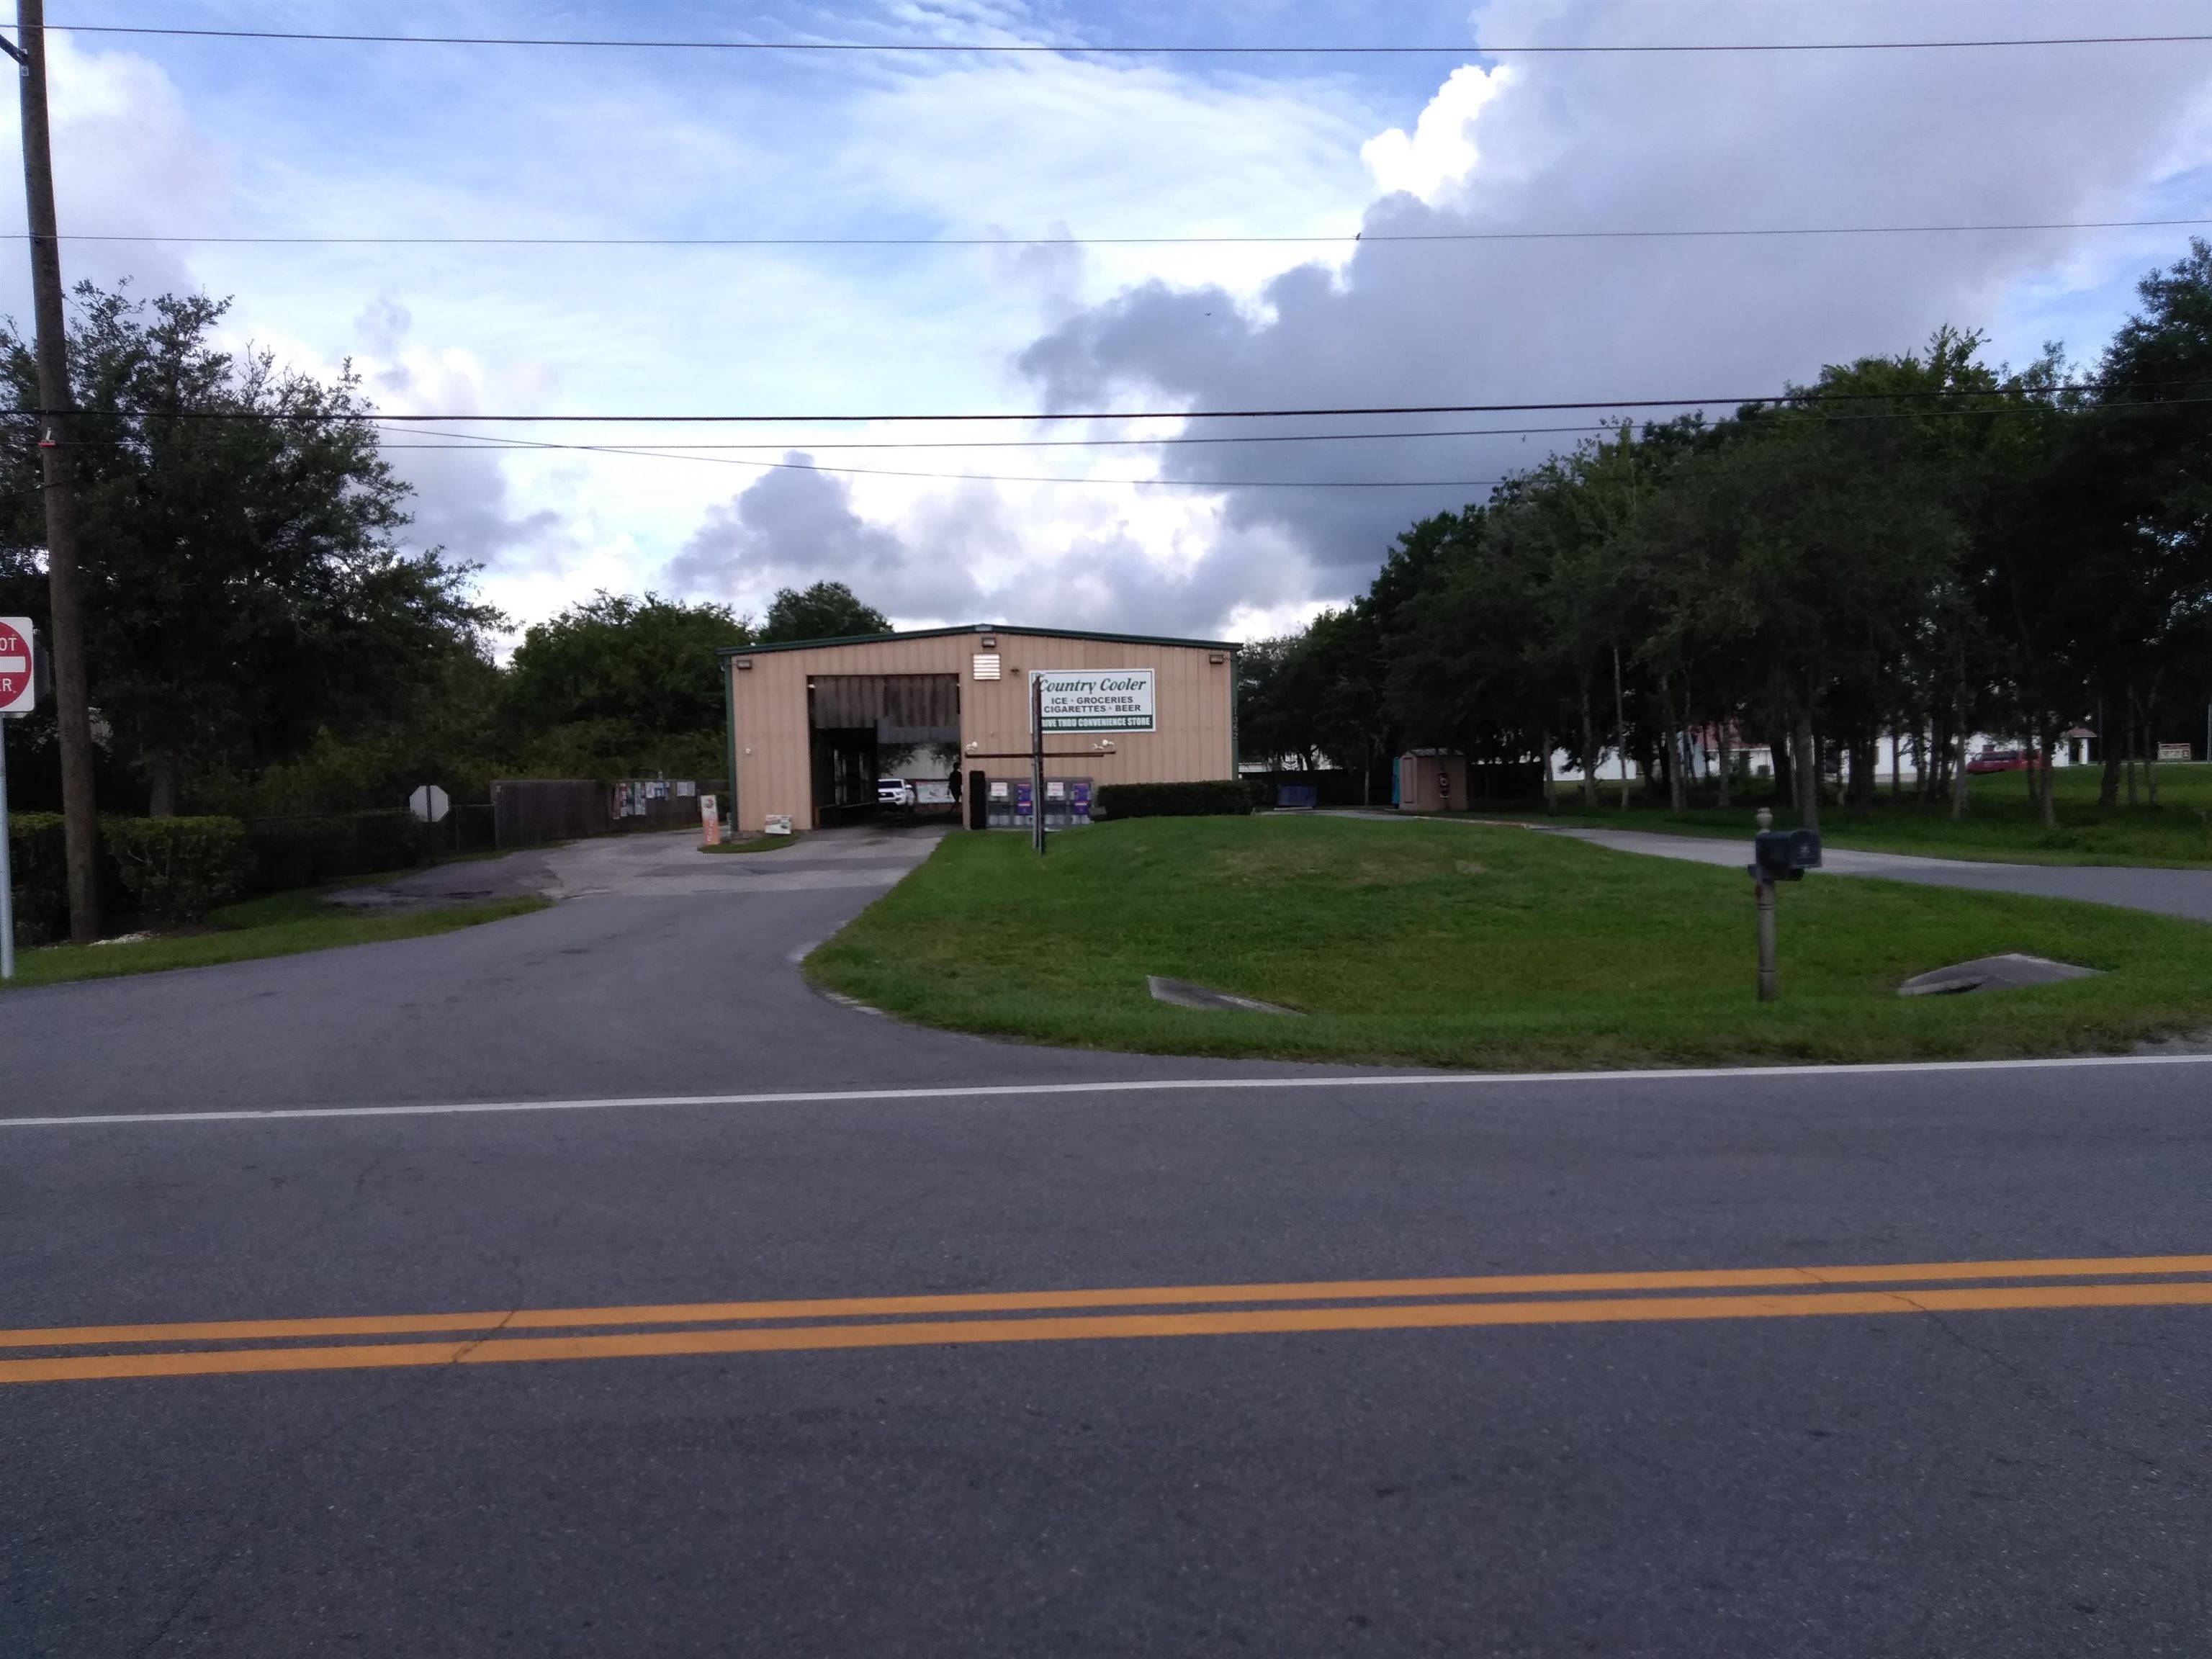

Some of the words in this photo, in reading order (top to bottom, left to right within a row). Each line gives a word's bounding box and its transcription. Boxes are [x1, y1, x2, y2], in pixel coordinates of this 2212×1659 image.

[0, 637, 17, 651] OT
[1040, 679, 1097, 694] Country
[1100, 678, 1146, 691] Cooler
[1058, 719, 1077, 727] THRU
[1078, 718, 1126, 727] CONVENIENCE
[1128, 716, 1150, 726] STORE
